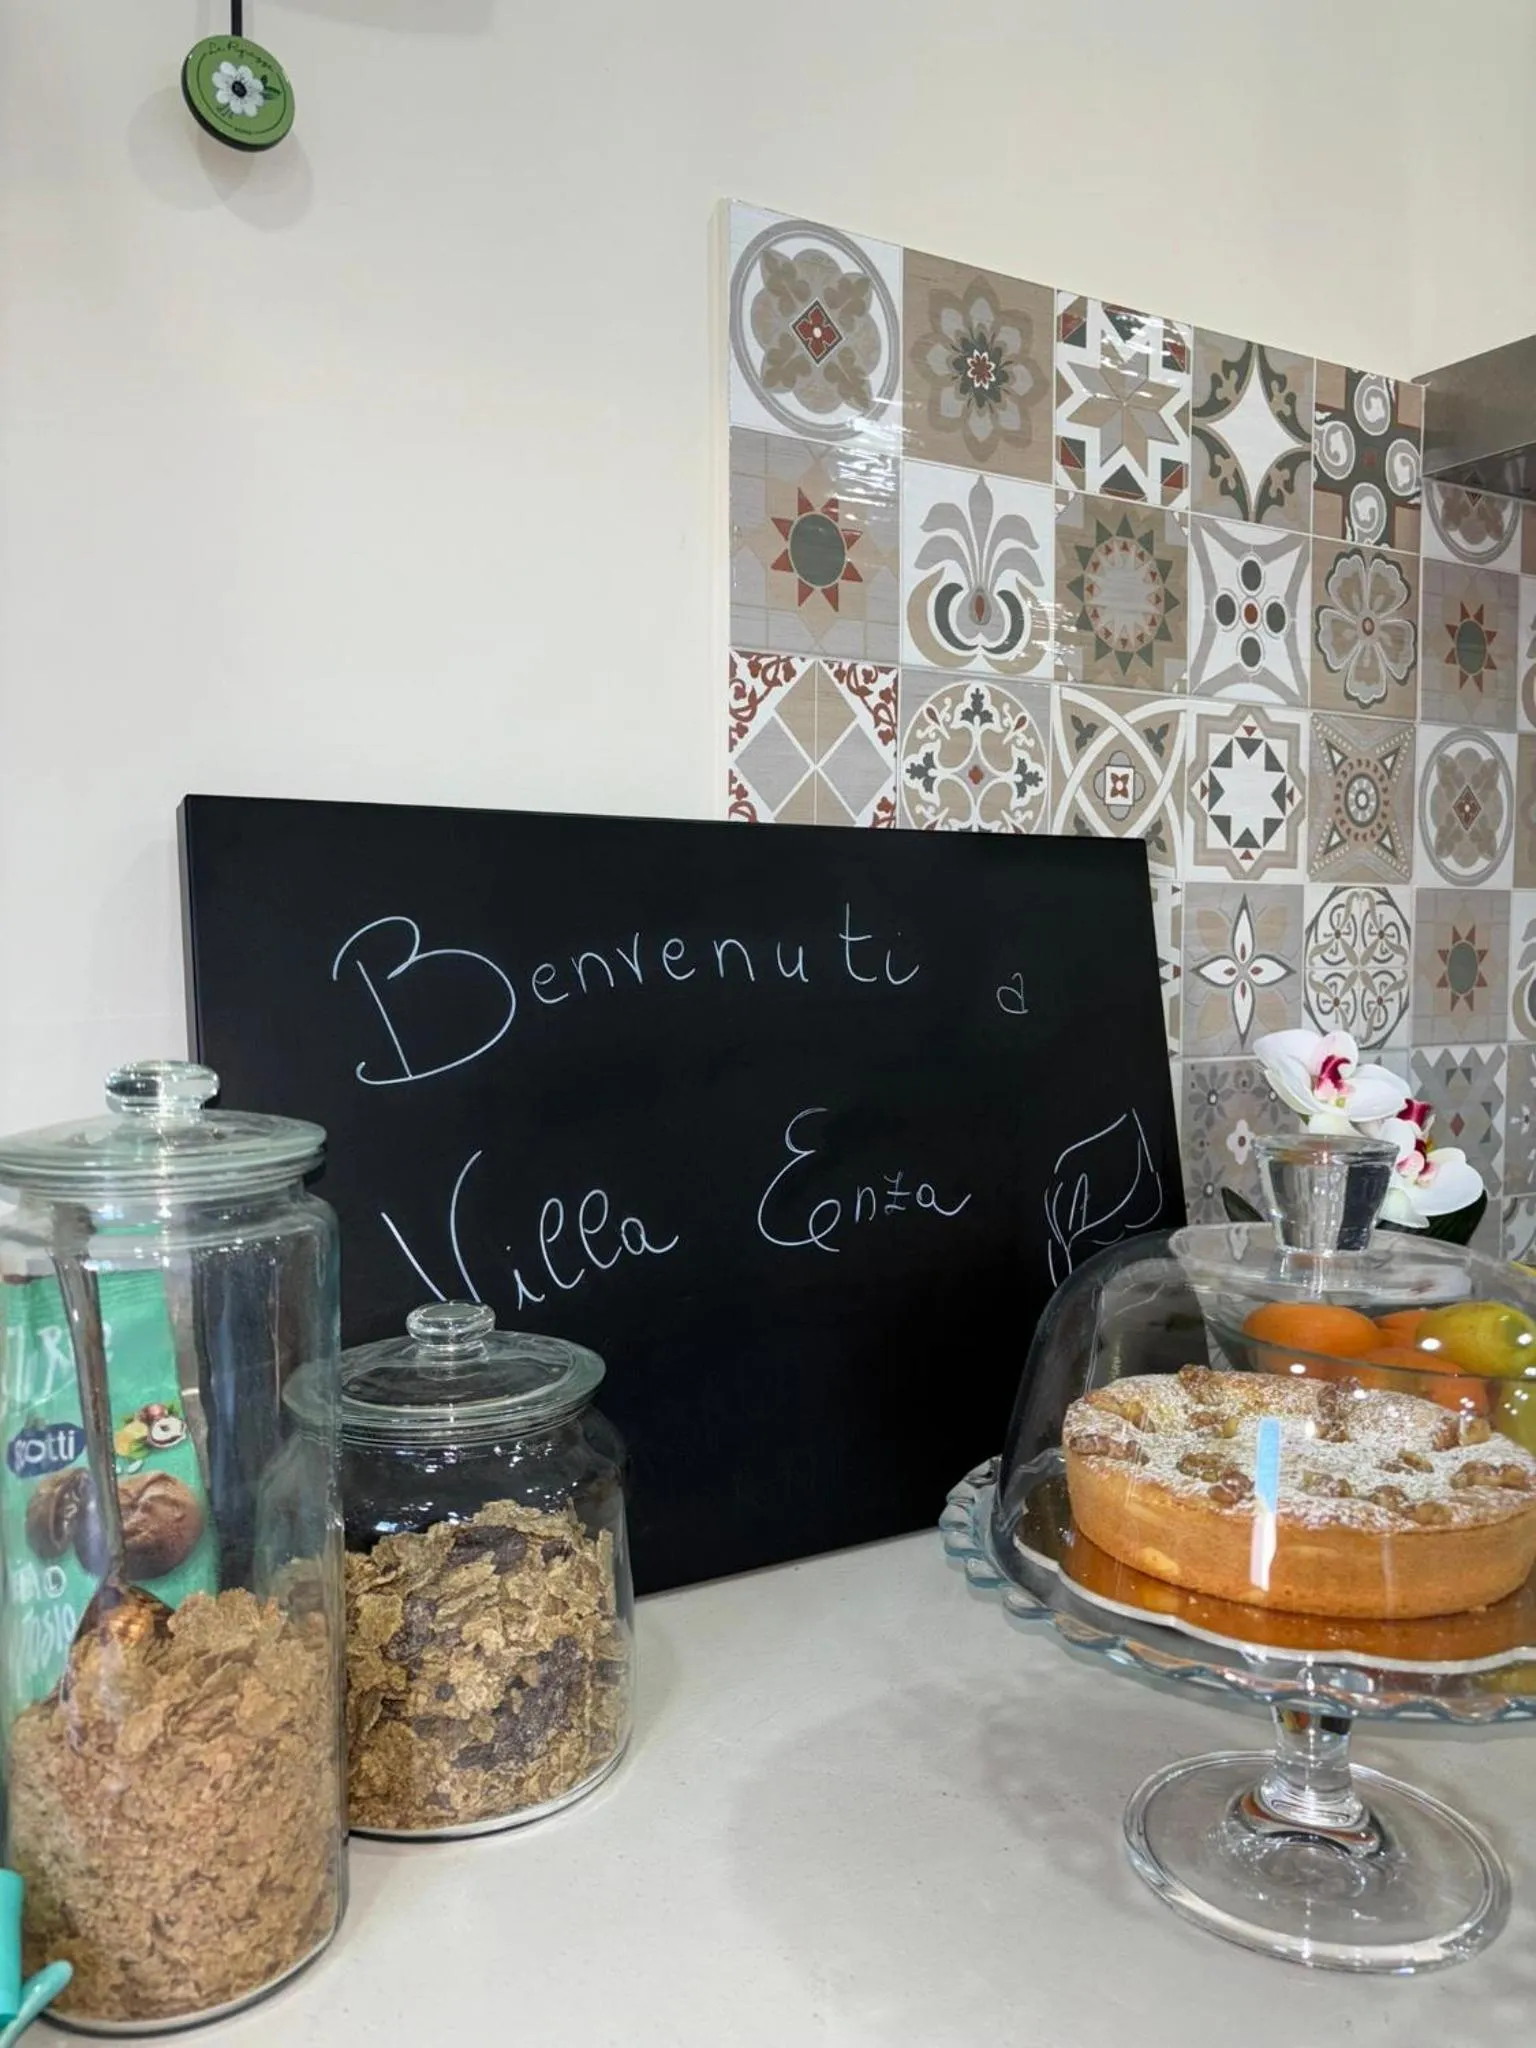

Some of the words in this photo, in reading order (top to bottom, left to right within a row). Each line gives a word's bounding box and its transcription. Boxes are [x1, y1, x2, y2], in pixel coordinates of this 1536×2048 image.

[332, 902, 921, 1086] Benvenuti
[995, 972, 1030, 1016] a
[380, 1149, 680, 1311] Villa
[757, 1107, 972, 1253] Enza
